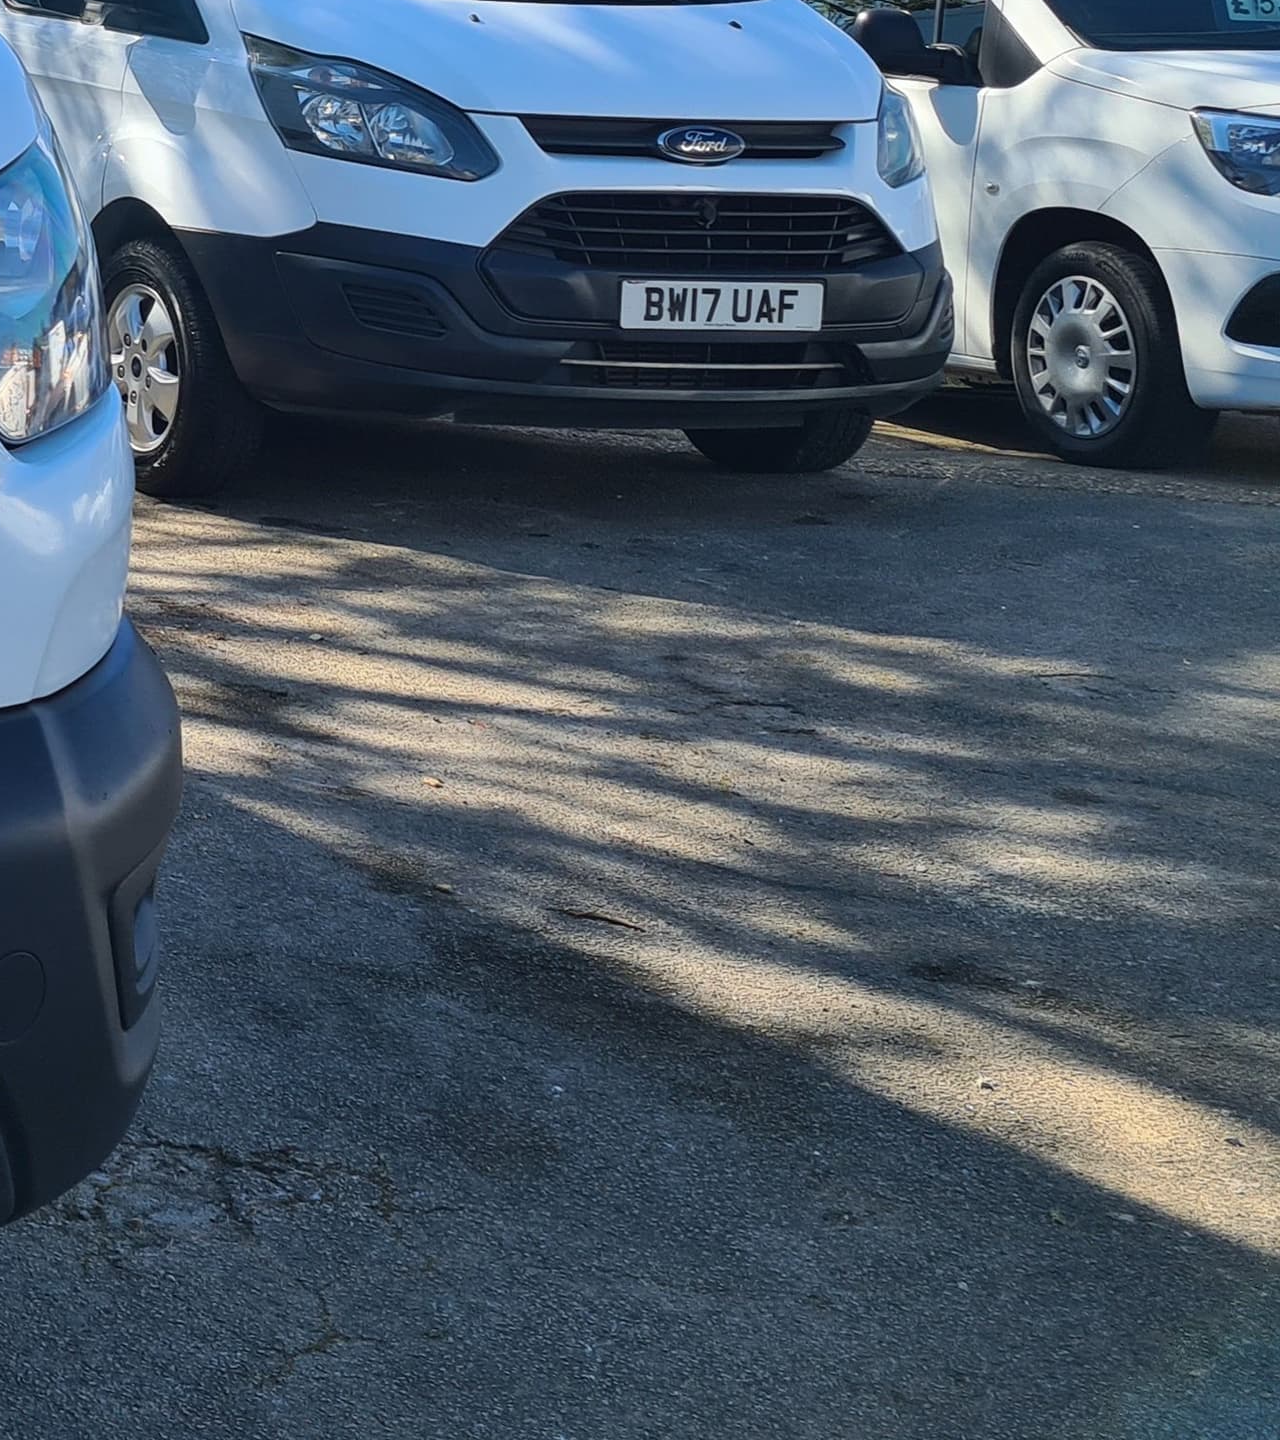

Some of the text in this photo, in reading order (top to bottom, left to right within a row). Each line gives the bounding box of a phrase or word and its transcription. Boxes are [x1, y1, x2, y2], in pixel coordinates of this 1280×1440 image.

[679, 130, 728, 152] Ford
[643, 286, 799, 324] BW17 UAF
